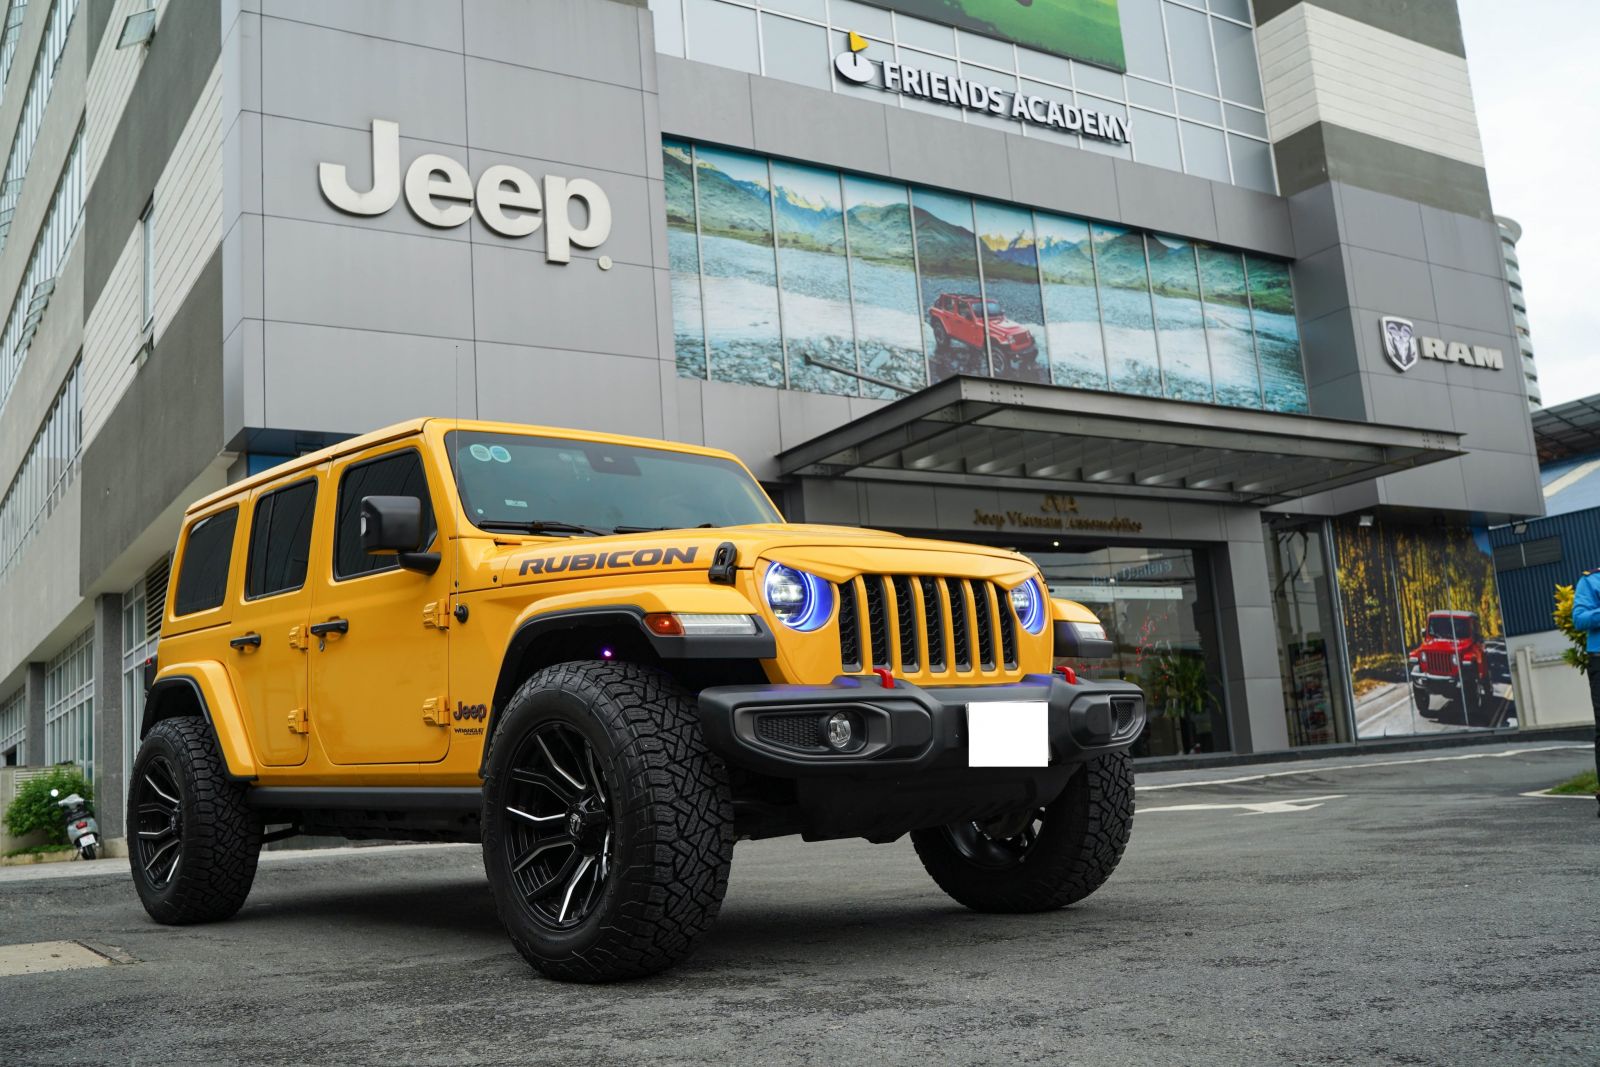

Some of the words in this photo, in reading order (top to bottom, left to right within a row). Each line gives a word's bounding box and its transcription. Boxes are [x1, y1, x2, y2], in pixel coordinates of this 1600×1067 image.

[882, 60, 1004, 114] FRIENDS
[1011, 92, 1133, 143] ACADEMY
[318, 118, 612, 265] Jeep
[1419, 335, 1504, 371] RAM
[973, 508, 1005, 529] Jeep
[518, 546, 699, 577] RUBICON
[453, 700, 487, 723] Jeep
